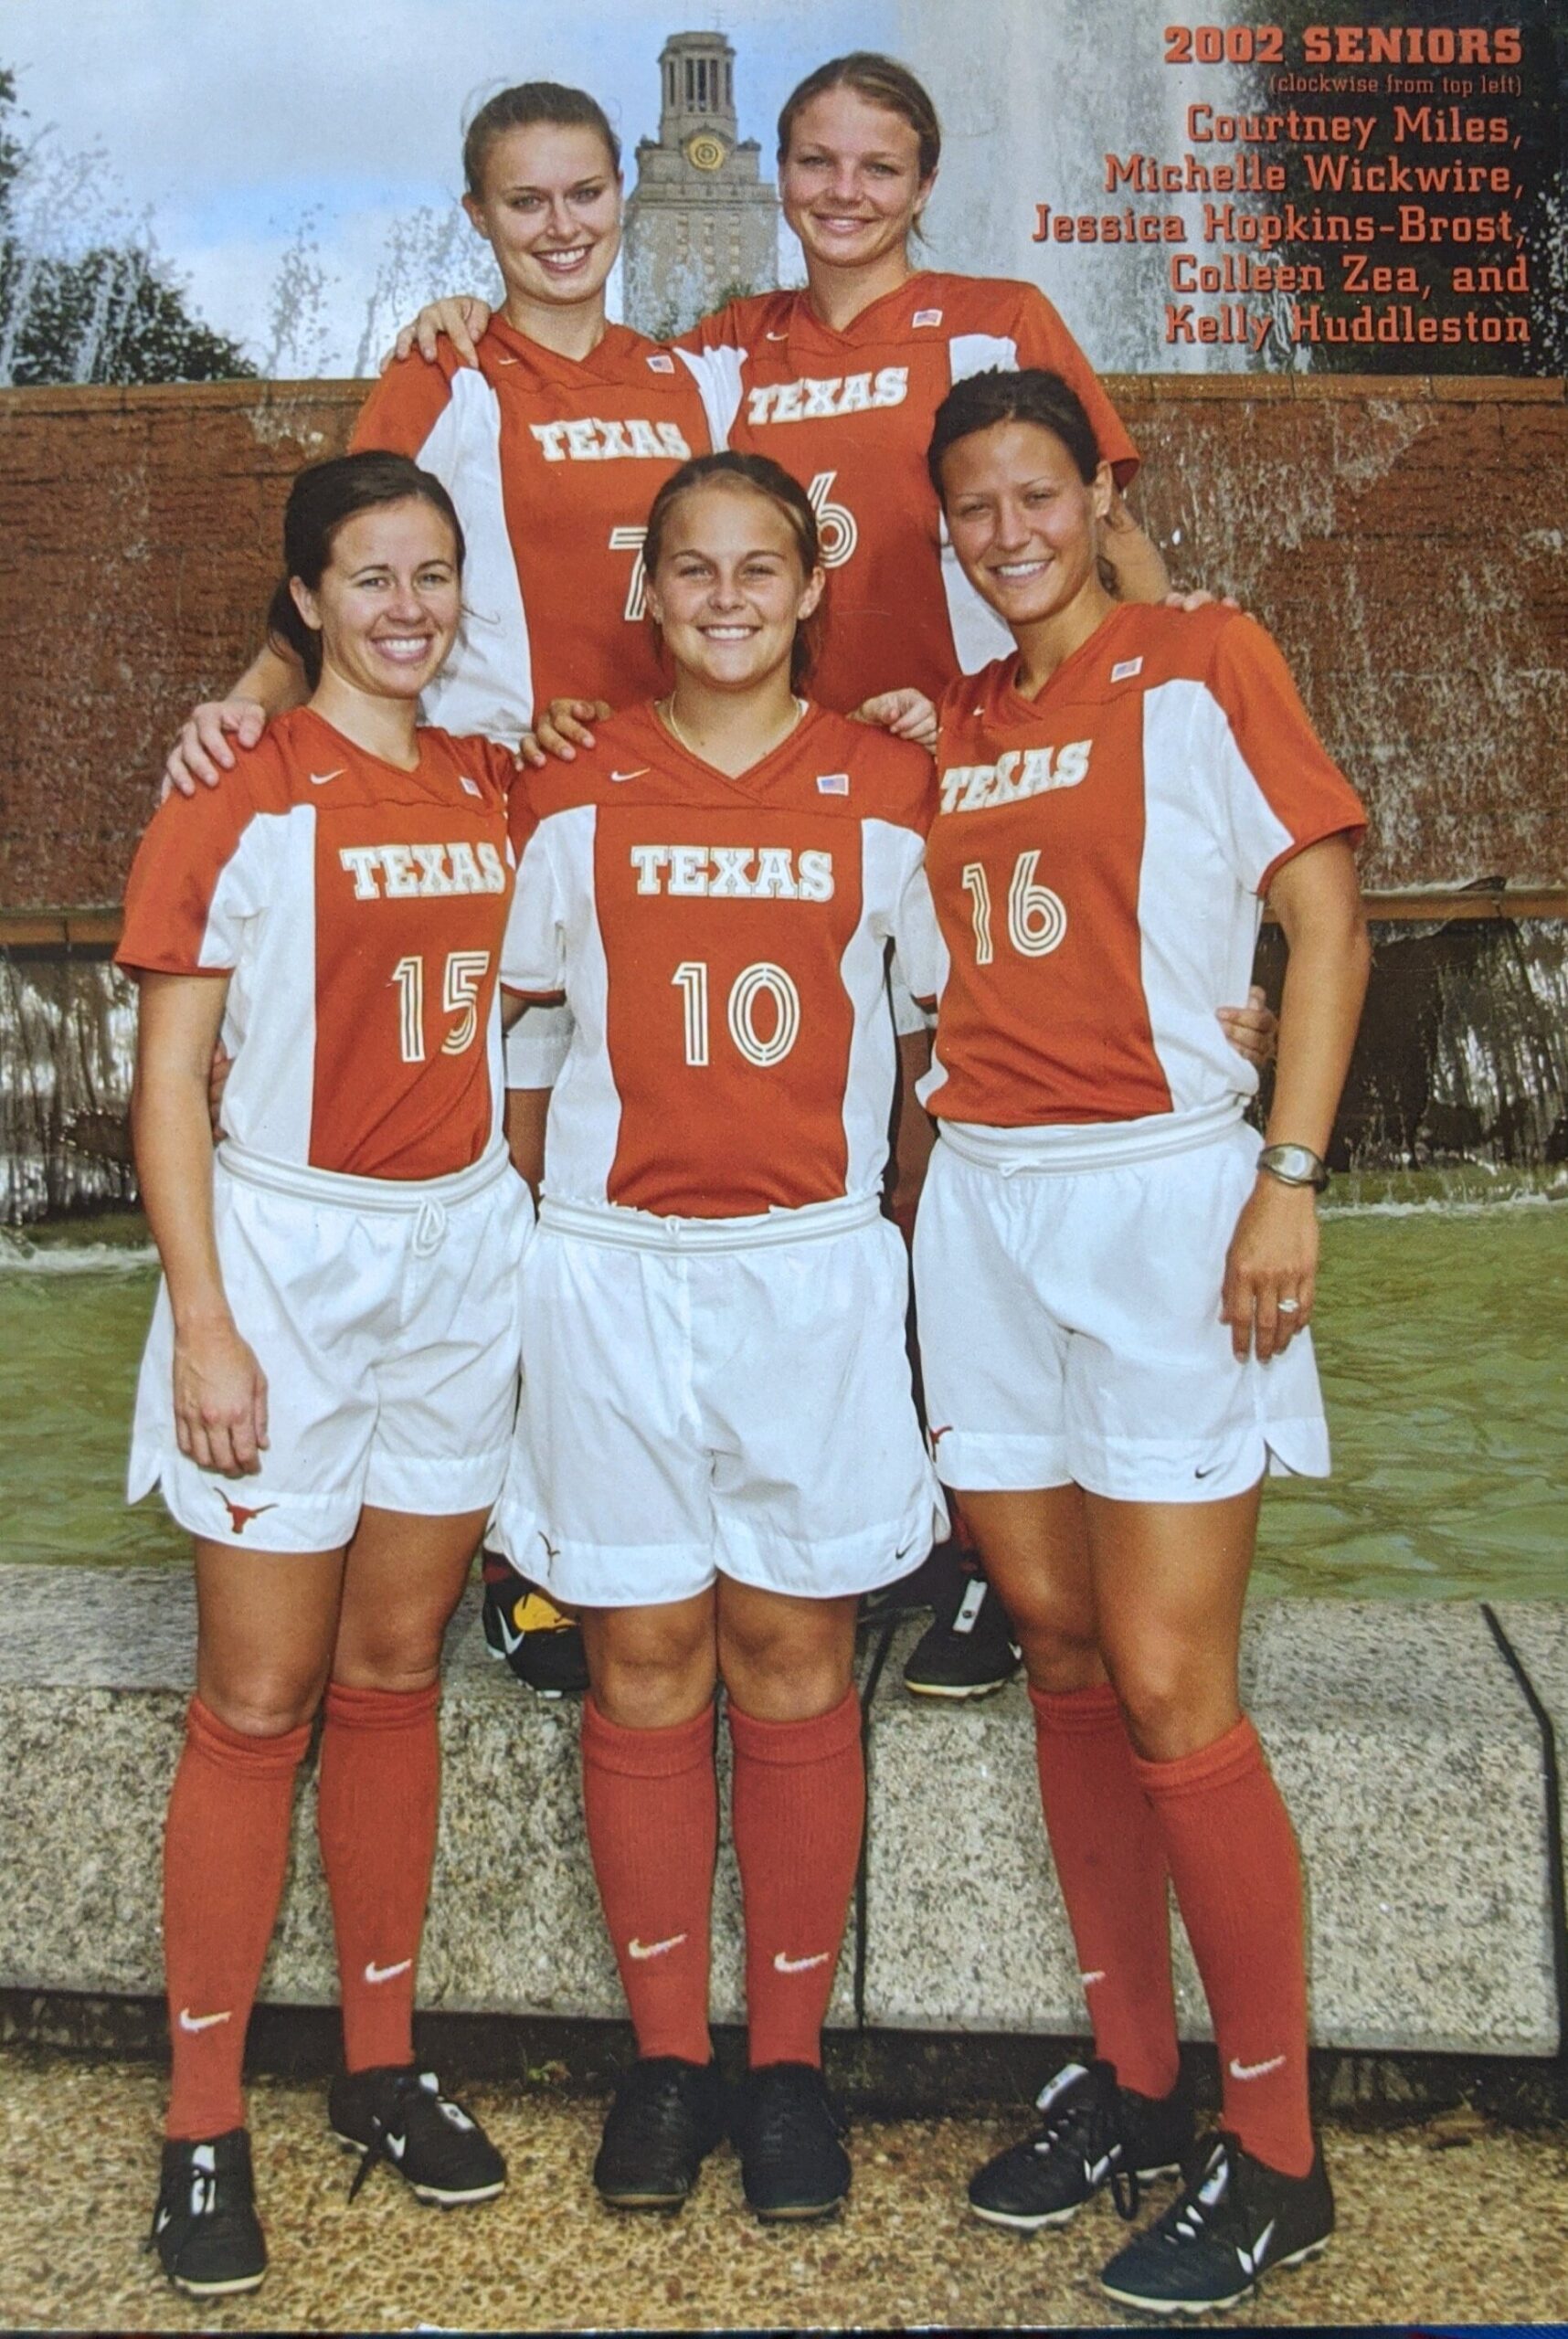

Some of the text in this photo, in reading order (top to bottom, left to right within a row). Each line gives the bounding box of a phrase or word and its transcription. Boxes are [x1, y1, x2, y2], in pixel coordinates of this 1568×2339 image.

[747, 367, 908, 426] TEXAS
[529, 419, 691, 461] TEXAS
[939, 739, 1093, 815] TEXAS
[339, 842, 507, 901] TEXAS
[630, 845, 834, 903] TEXAS
[962, 850, 1067, 965] 16
[390, 951, 491, 1063] 15
[672, 962, 800, 1067] 10
